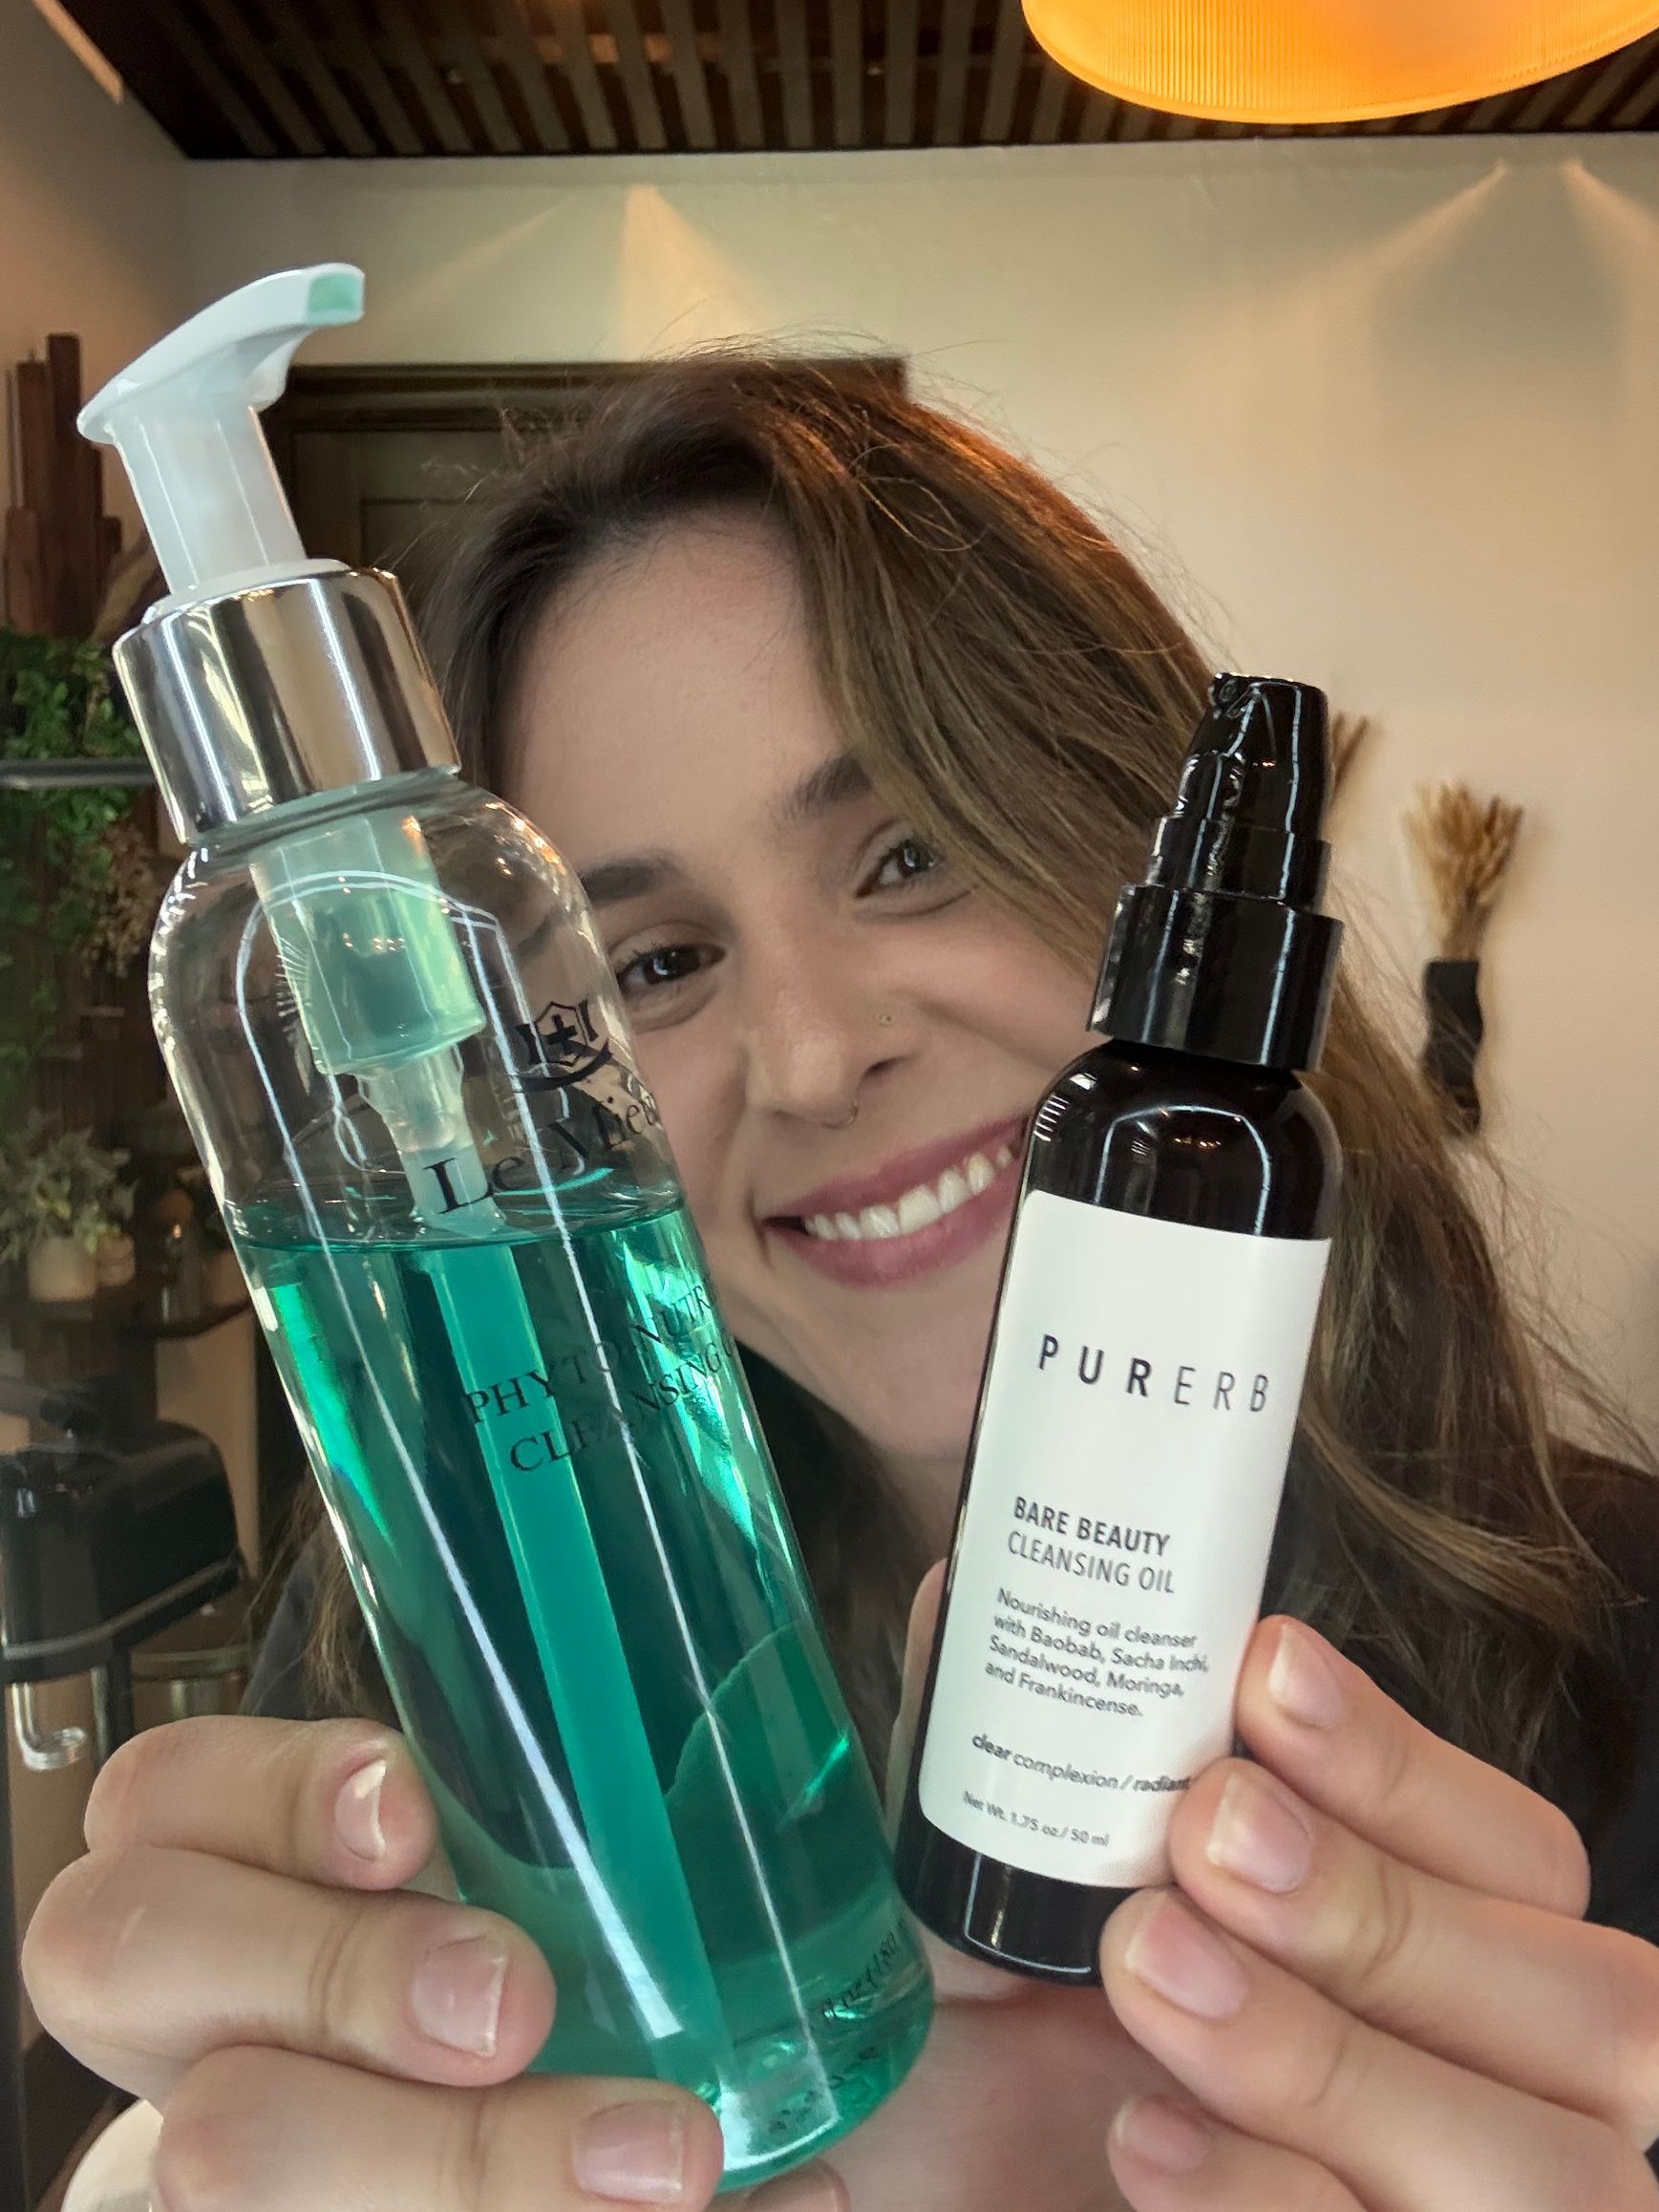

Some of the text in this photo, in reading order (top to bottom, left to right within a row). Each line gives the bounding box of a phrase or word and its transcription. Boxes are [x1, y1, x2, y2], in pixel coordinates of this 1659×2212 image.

[464, 1339, 621, 1424] PHYTO
[632, 1285, 713, 1345] NUTR
[1038, 1333, 1270, 1413] PURERB
[1013, 1496, 1172, 1558] BARE BEAUTY
[1007, 1530, 1176, 1595] CLEANSING OIL
[993, 1614, 1027, 1639] with
[1030, 1626, 1106, 1665] Baobab,
[1110, 1648, 1165, 1671] Sacha
[997, 1586, 1199, 1648] Nourishing oil cleanser
[984, 1661, 1144, 1717] and Frankincense.
[988, 1634, 1102, 1689] Sandalwood,
[970, 1733, 1013, 1761] clear
[1013, 1753, 1118, 1791] complexion
[1118, 1774, 1134, 1792] /
[1010, 1811, 1039, 1833] 1.75
[1071, 1826, 1090, 1845] 50
[1091, 1831, 1111, 1848] ml
